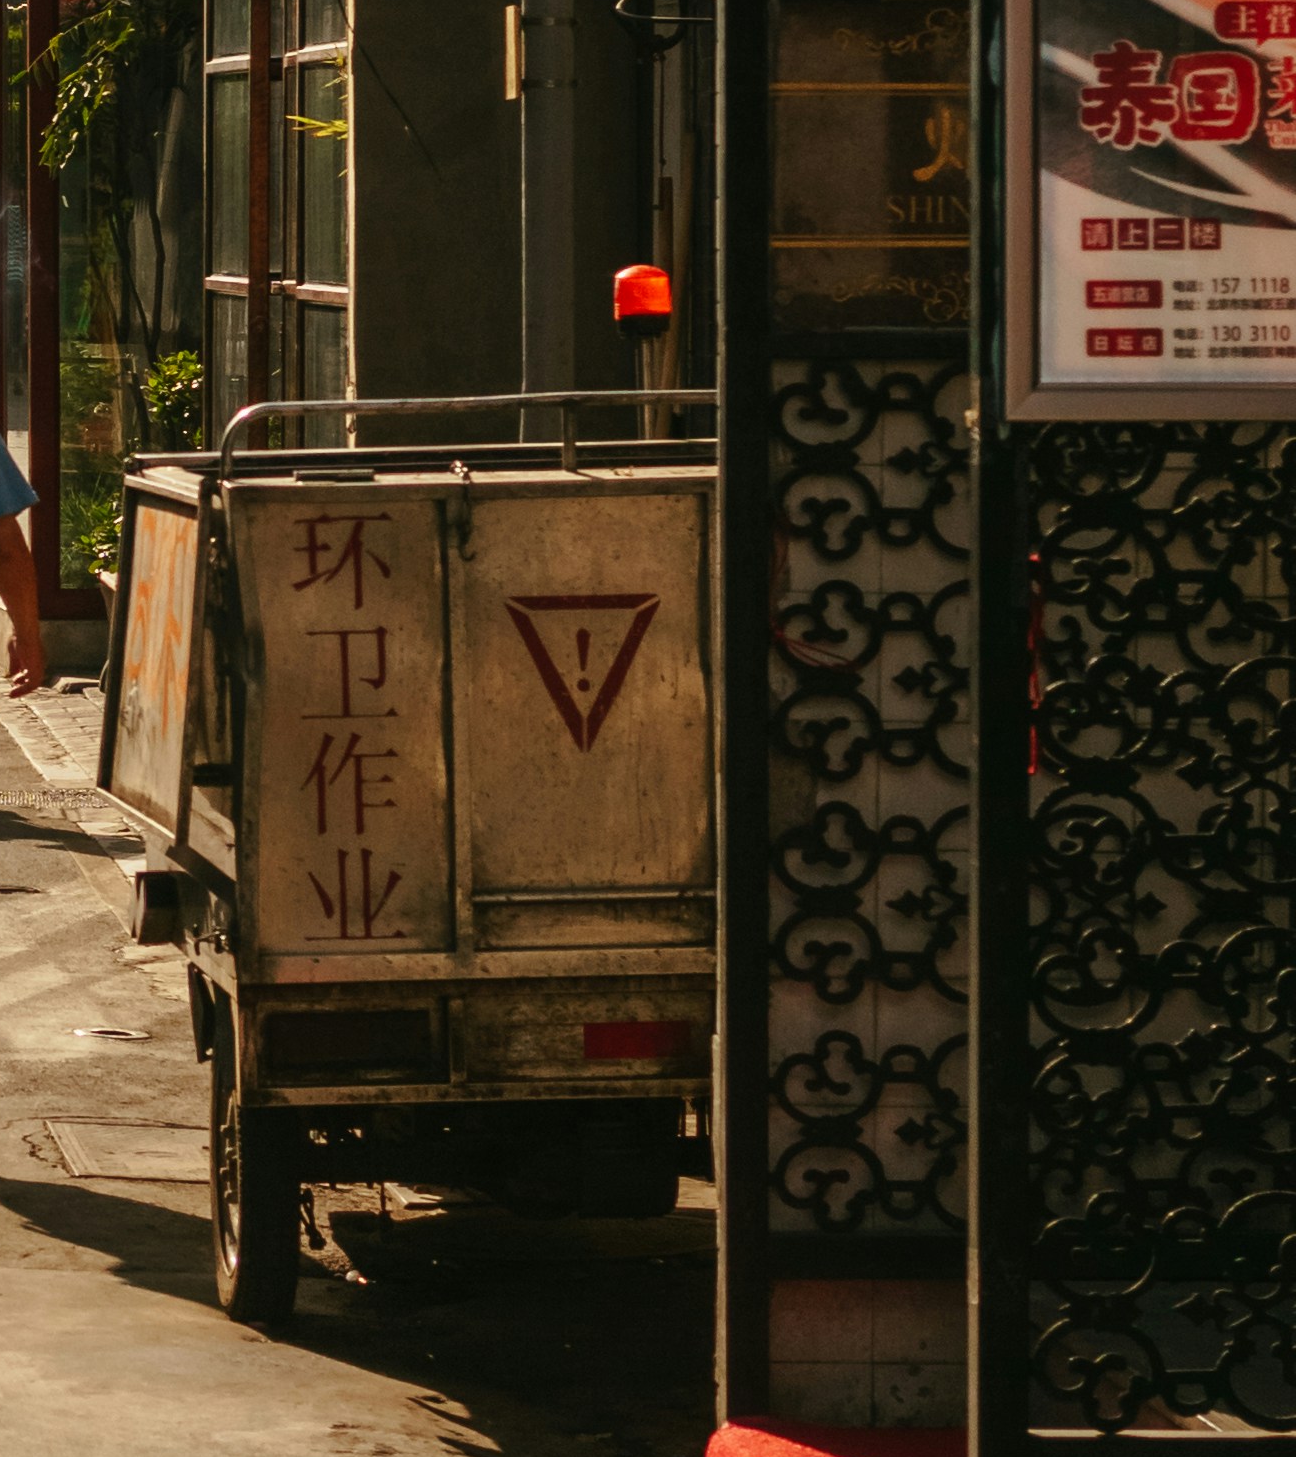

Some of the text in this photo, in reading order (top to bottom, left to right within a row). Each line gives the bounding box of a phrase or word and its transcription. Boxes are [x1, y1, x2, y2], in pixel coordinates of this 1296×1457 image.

[1230, 4, 1294, 35] 主营
[1084, 221, 1219, 247] 请上二楼
[1212, 277, 1241, 294] 157
[1250, 277, 1290, 294] 1118
[1212, 325, 1242, 342] 130
[1249, 325, 1291, 342] 3110
[292, 511, 408, 941] 环卫作业
